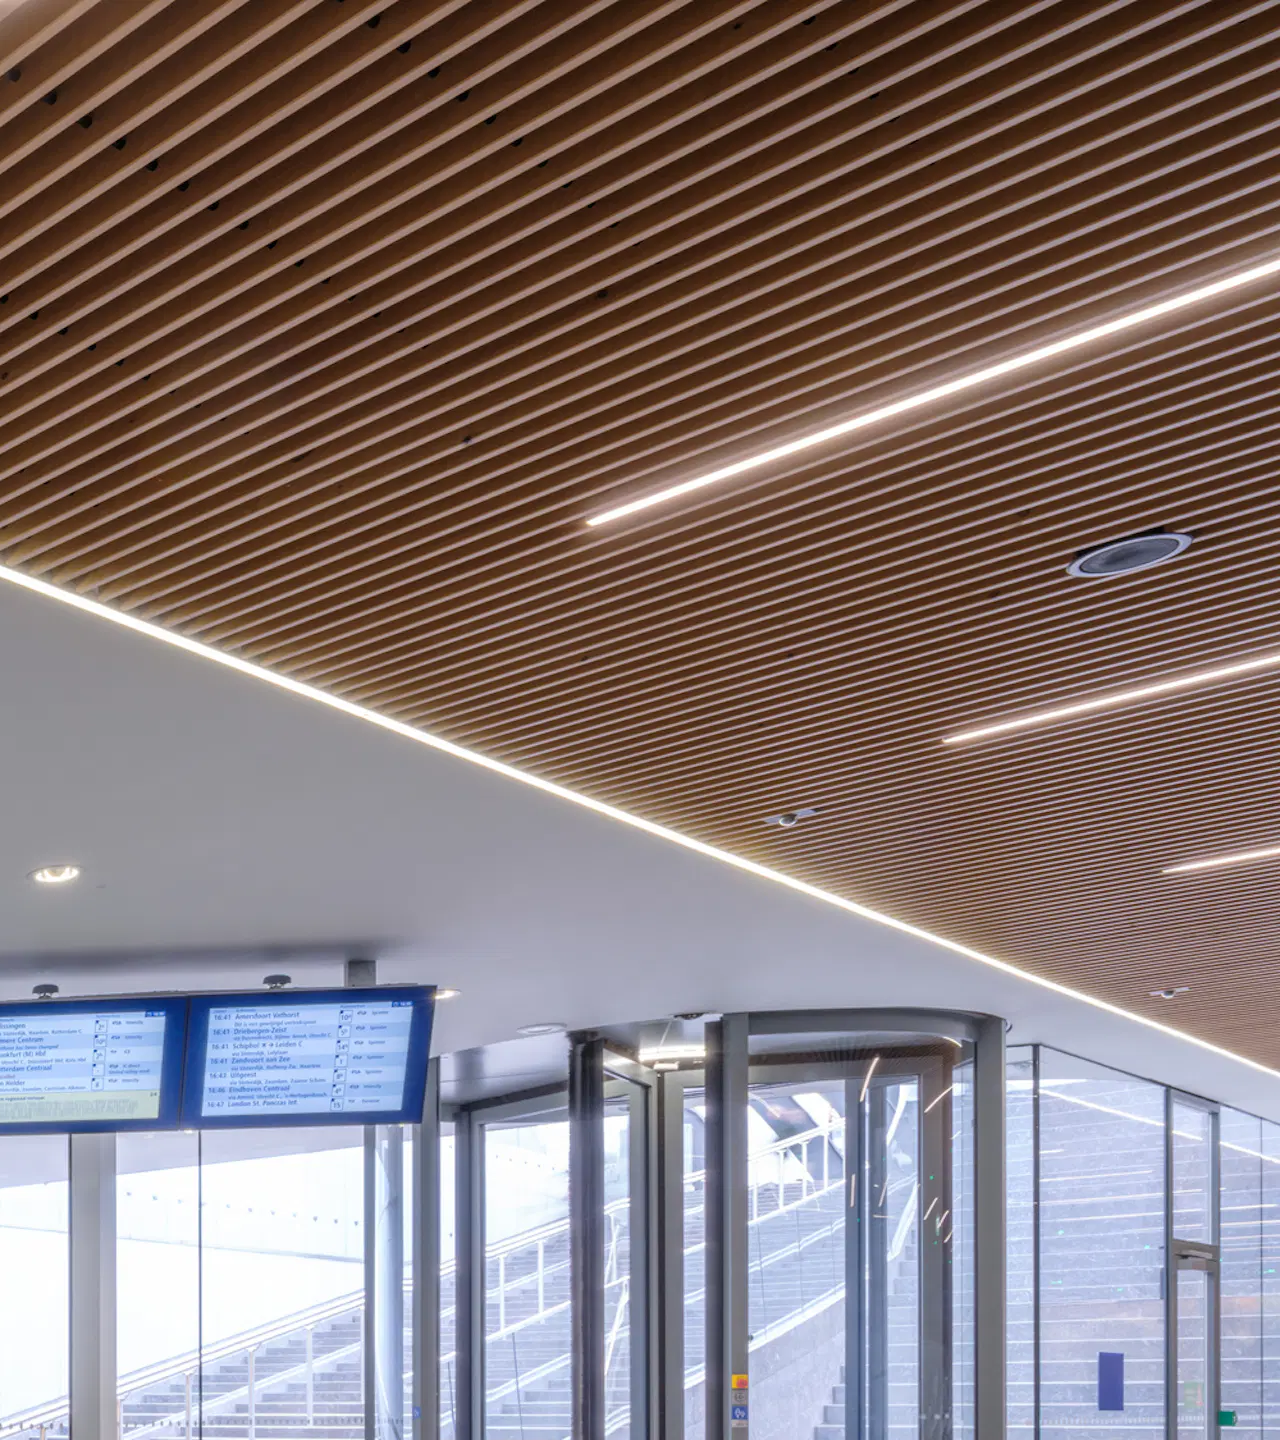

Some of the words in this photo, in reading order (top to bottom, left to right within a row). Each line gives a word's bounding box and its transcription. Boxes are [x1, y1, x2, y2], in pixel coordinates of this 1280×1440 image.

[231, 1042, 259, 1050] Schiphol
[231, 1056, 264, 1064] Zandvoort
[278, 1054, 291, 1062] Zee
[229, 1071, 257, 1079] Uitgeest
